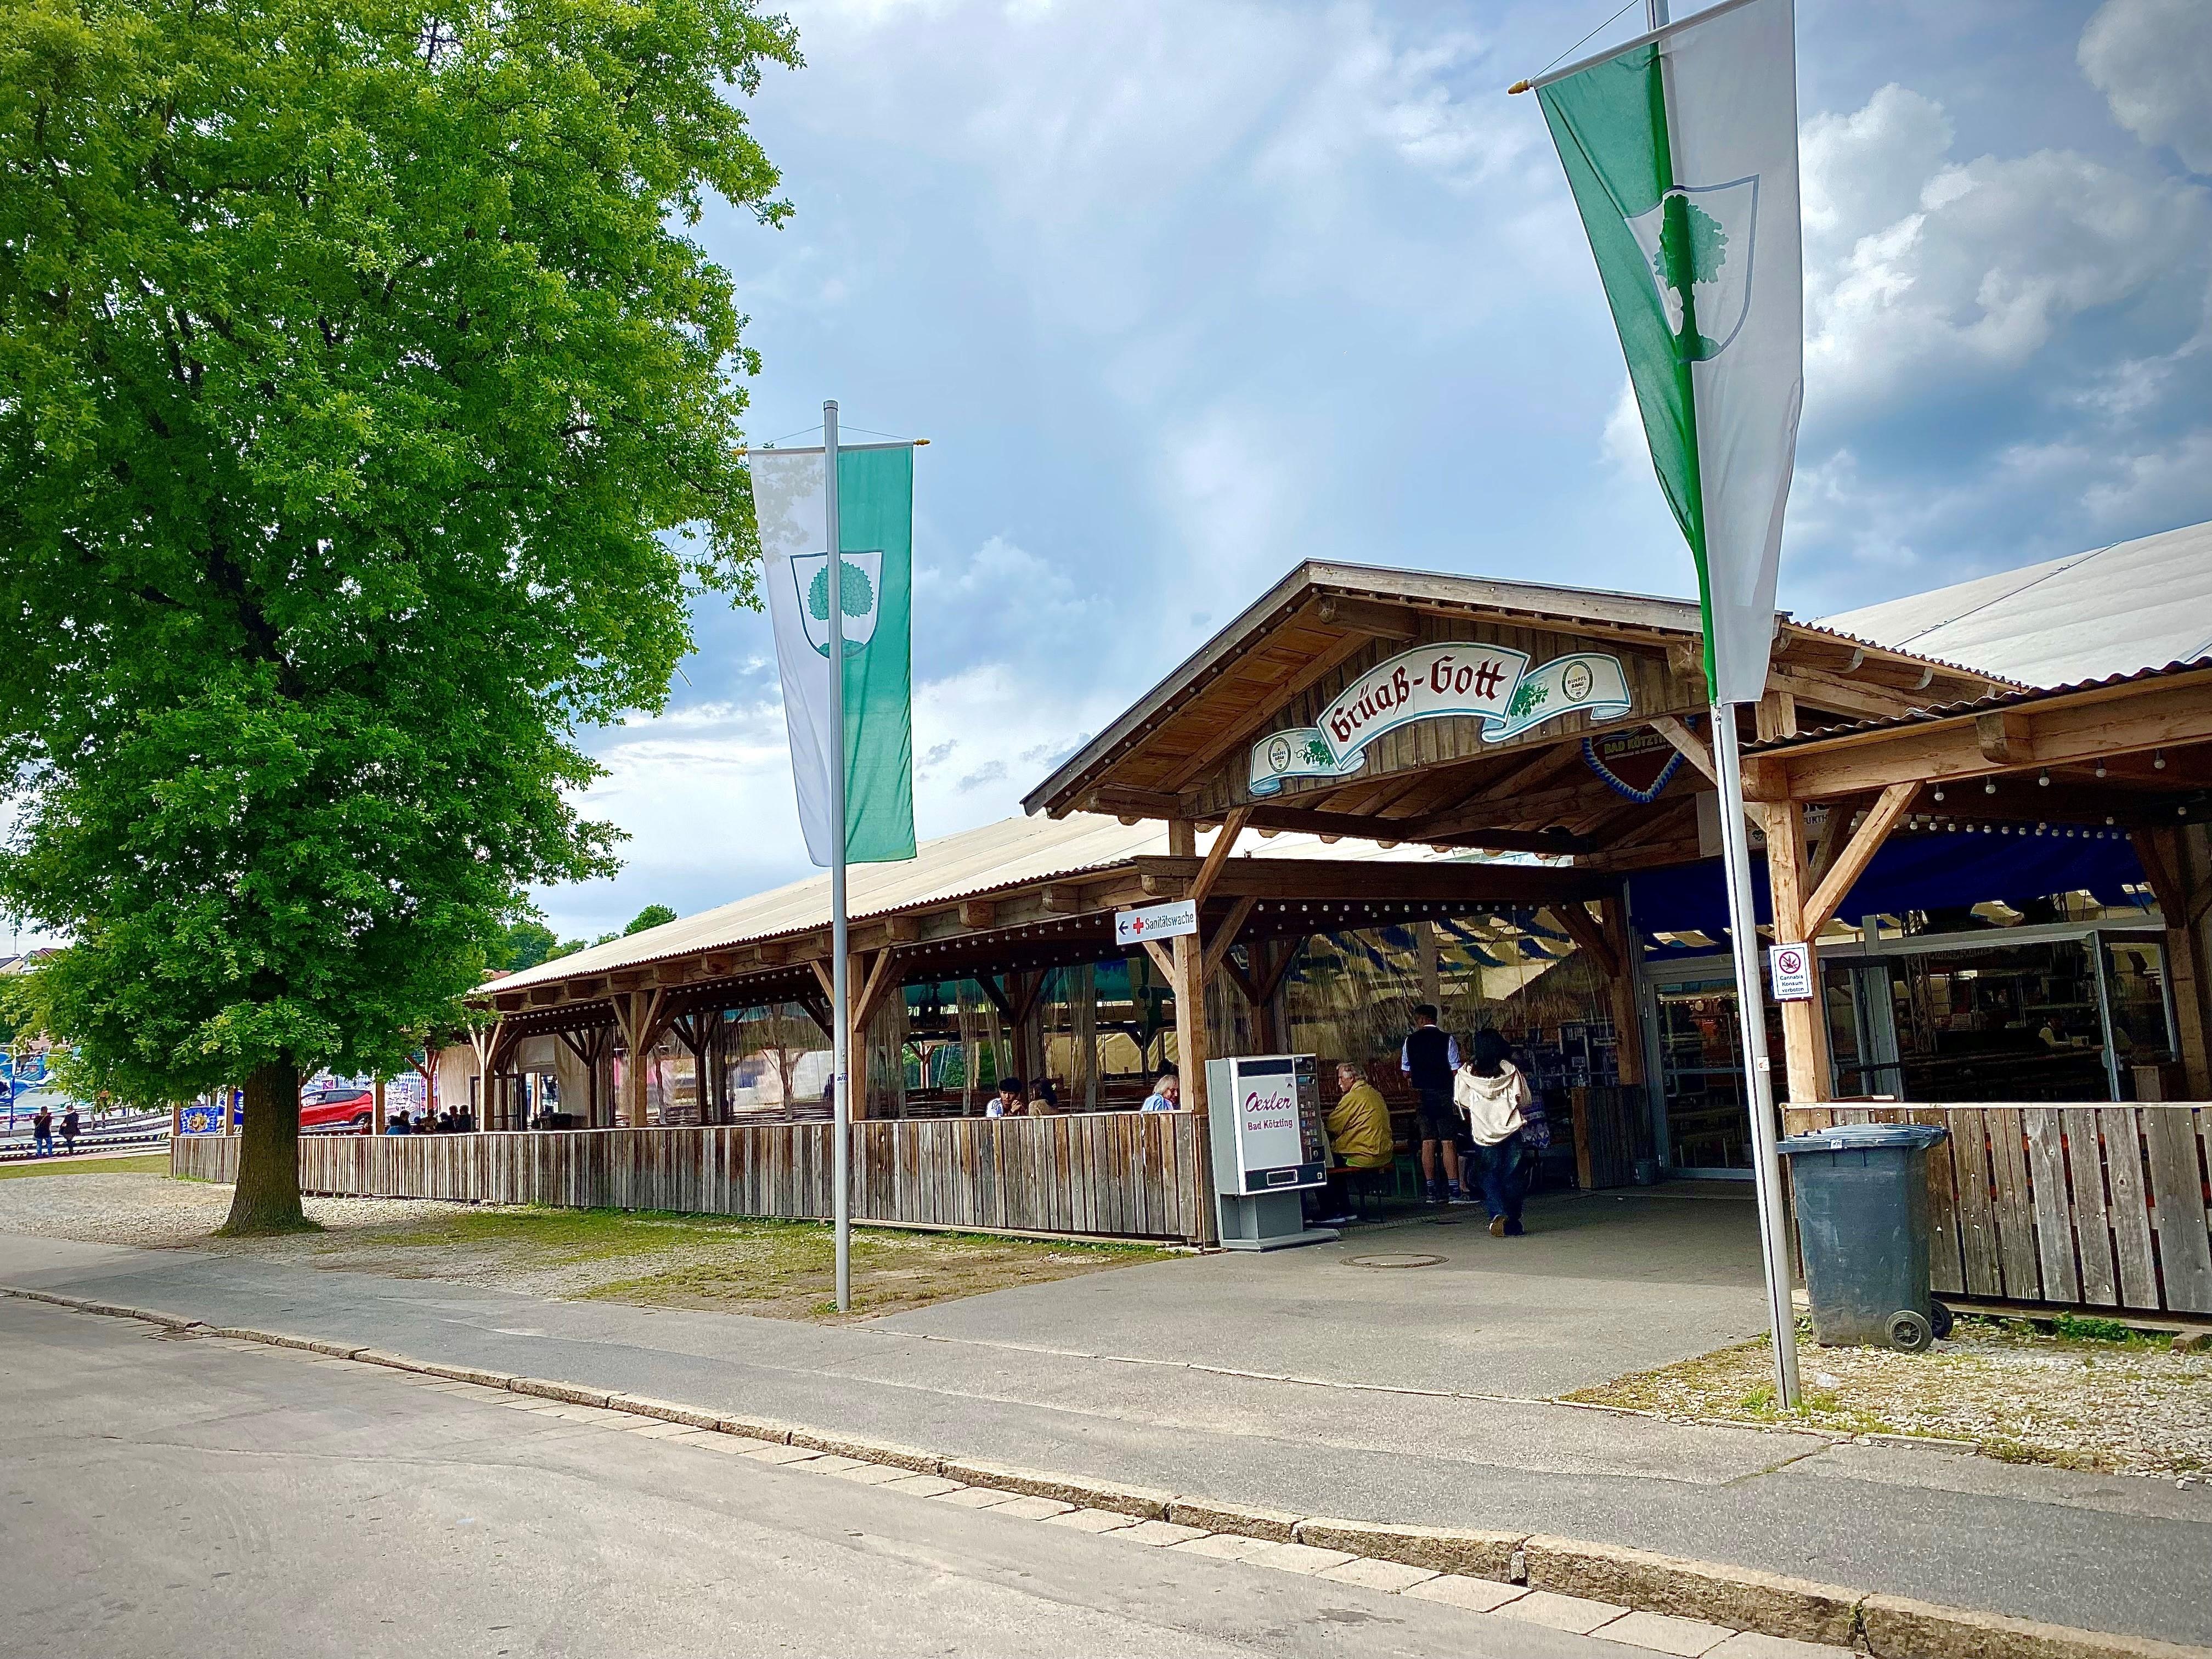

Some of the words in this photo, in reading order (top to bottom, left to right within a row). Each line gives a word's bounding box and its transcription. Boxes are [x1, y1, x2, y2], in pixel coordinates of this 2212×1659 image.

[1604, 741, 1625, 754] BAD
[1145, 911, 1194, 930] Sanitätswache
[1245, 1091, 1292, 1113] Oexler
[1248, 1121, 1261, 1131] Bad
[1263, 1118, 1293, 1128] Kötzting
